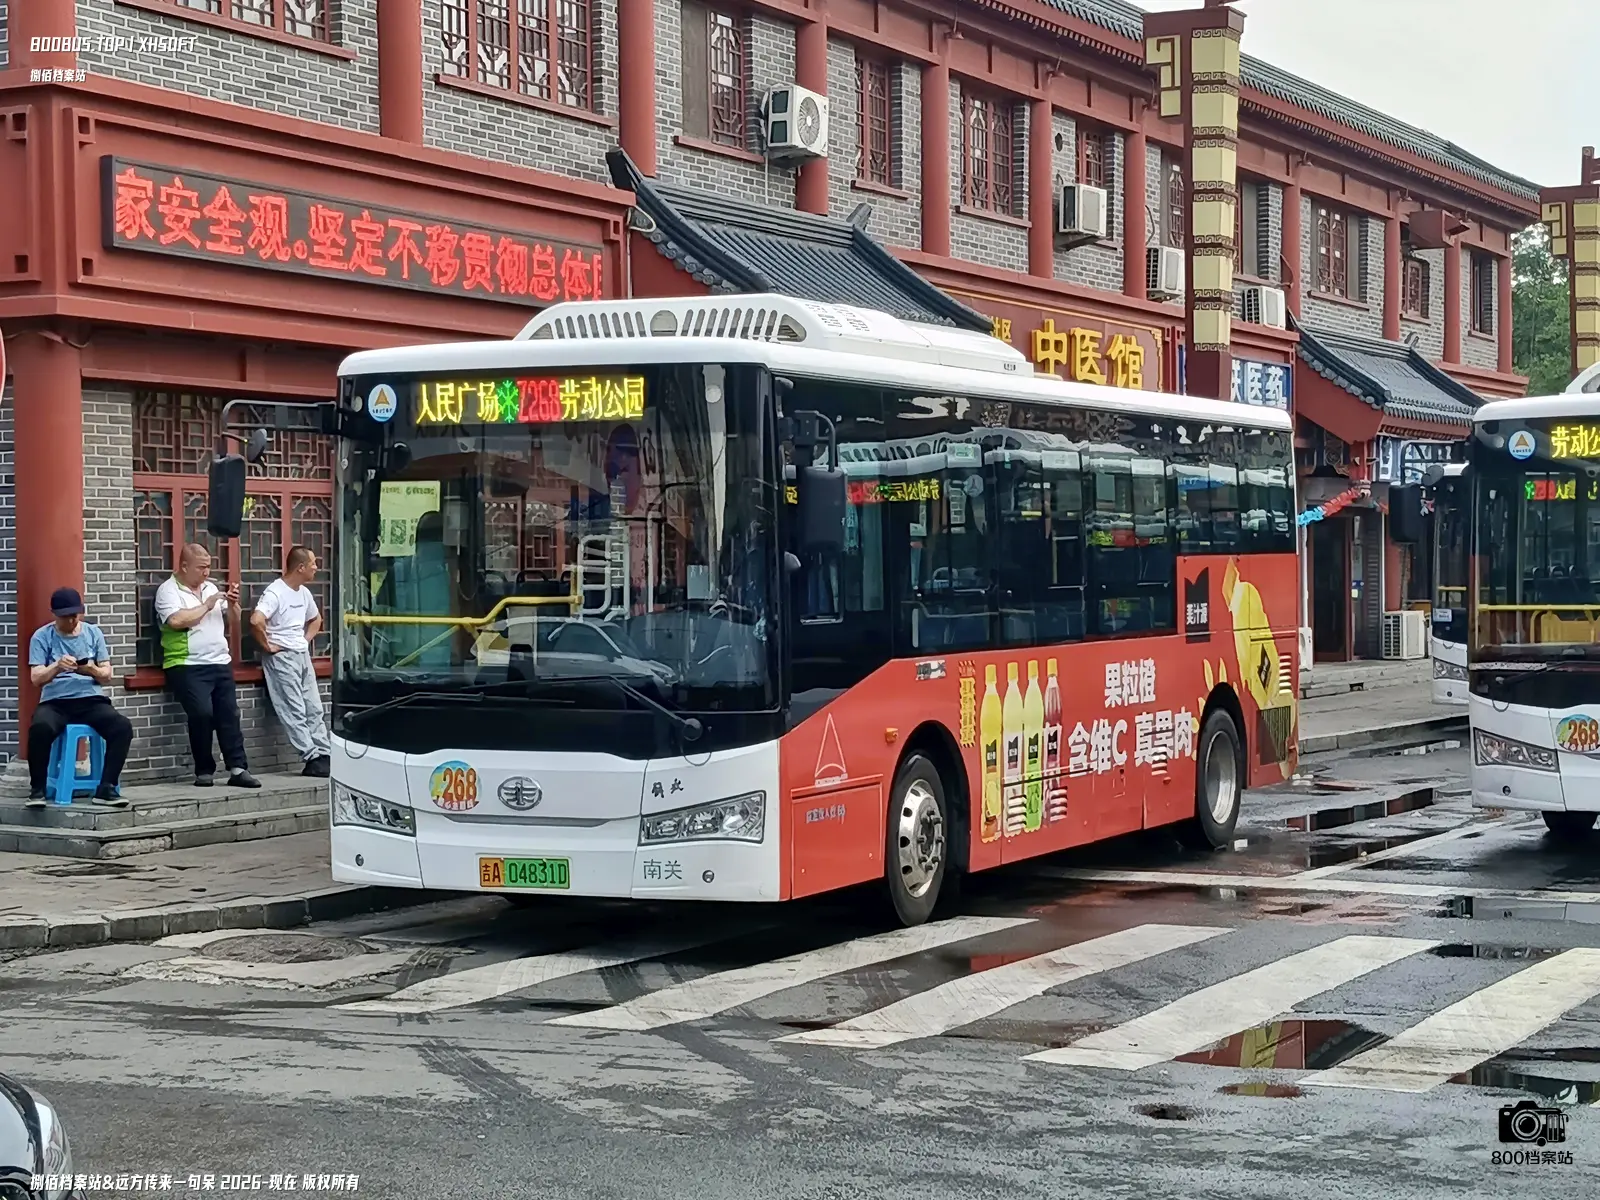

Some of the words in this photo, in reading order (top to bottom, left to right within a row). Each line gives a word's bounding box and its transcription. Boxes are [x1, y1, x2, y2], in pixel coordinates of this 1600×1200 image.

[1032, 318, 1145, 390] 中医馆
[416, 381, 499, 424] 人民广场
[517, 379, 560, 421] Z268
[558, 376, 645, 420] 劳动公园
[1104, 658, 1156, 708] 果粒橙
[1068, 718, 1128, 777] 含维C
[1134, 706, 1192, 767] 真果肉
[1568, 718, 1599, 747] 268
[443, 767, 477, 801] 268
[481, 862, 501, 882] 吉A
[508, 862, 567, 885] 04831D
[643, 859, 683, 880] 南关
